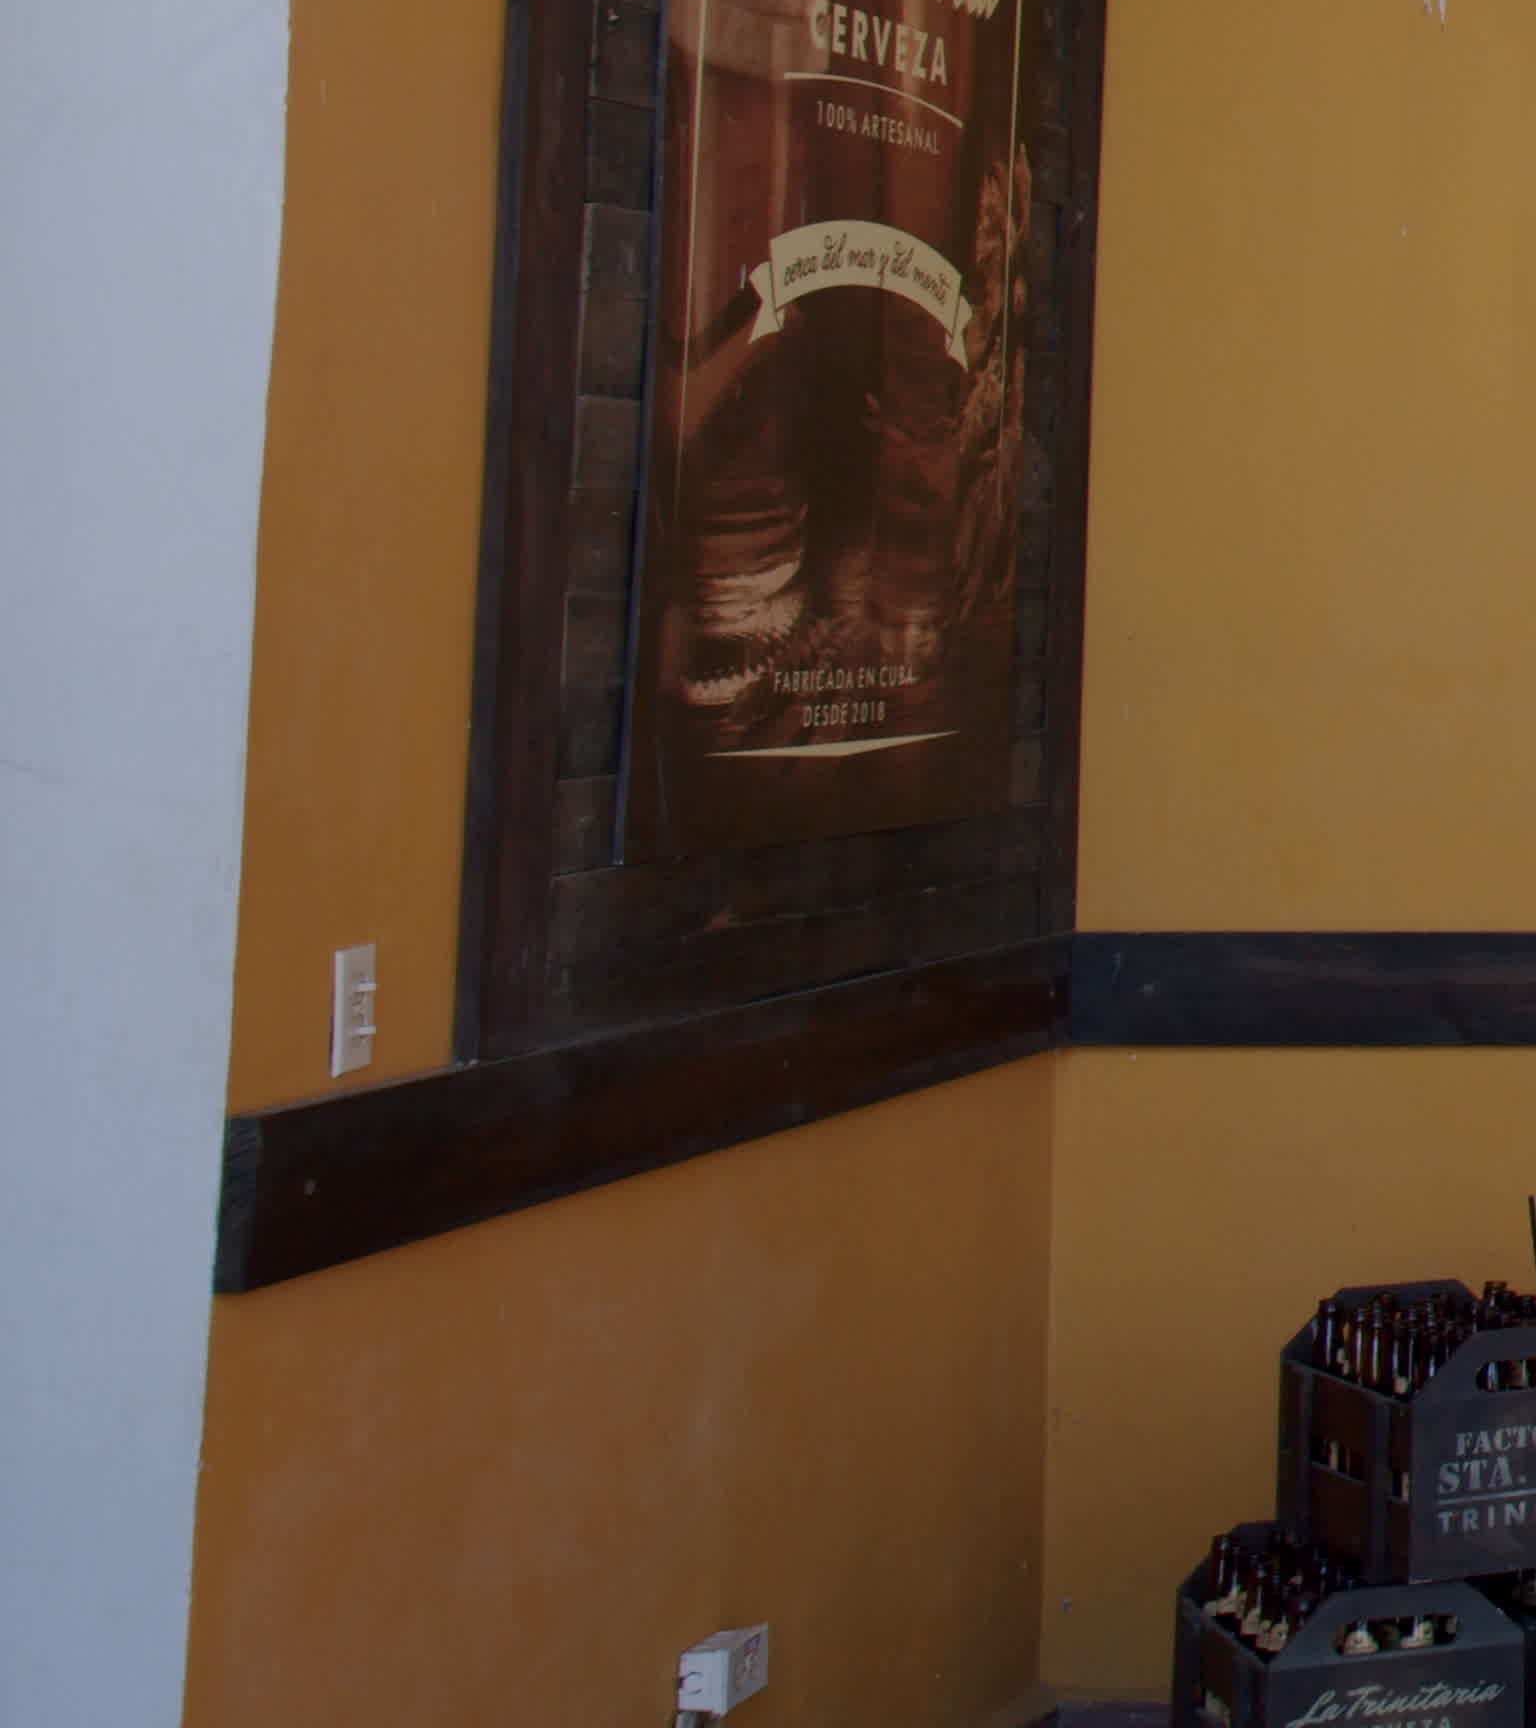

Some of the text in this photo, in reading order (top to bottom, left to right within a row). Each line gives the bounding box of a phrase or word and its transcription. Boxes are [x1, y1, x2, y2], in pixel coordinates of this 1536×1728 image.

[815, 99, 942, 156] 100% ARTESANAL
[773, 668, 854, 693] FABRICADA
[857, 666, 875, 688] EN
[802, 700, 886, 728] DESDE 2018
[1437, 1455, 1528, 1495] STA.
